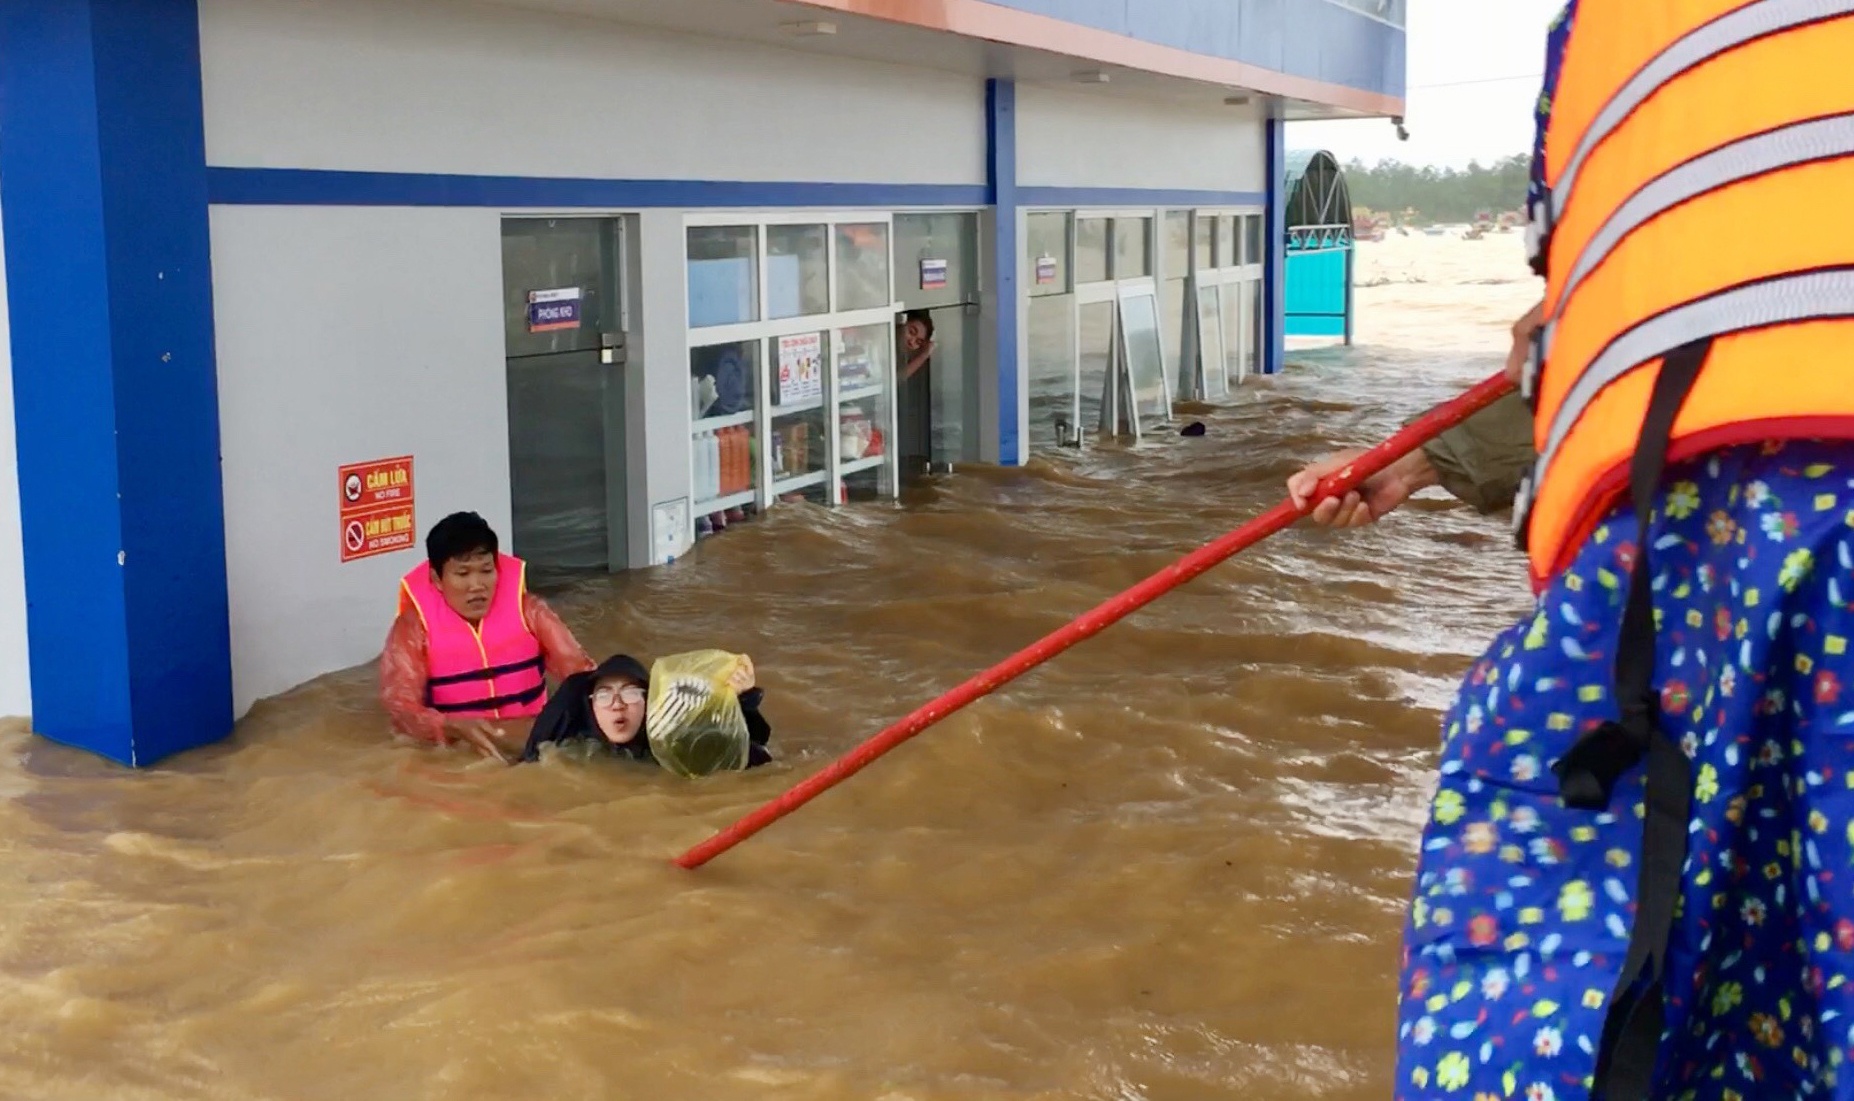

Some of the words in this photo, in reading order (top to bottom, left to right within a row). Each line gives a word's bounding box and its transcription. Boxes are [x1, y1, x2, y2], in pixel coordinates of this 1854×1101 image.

[390, 464, 408, 485] LỬA
[374, 490, 385, 499] NO
[385, 488, 401, 497] FIRE
[368, 538, 379, 549] NO
[379, 533, 410, 546] SMOKING
